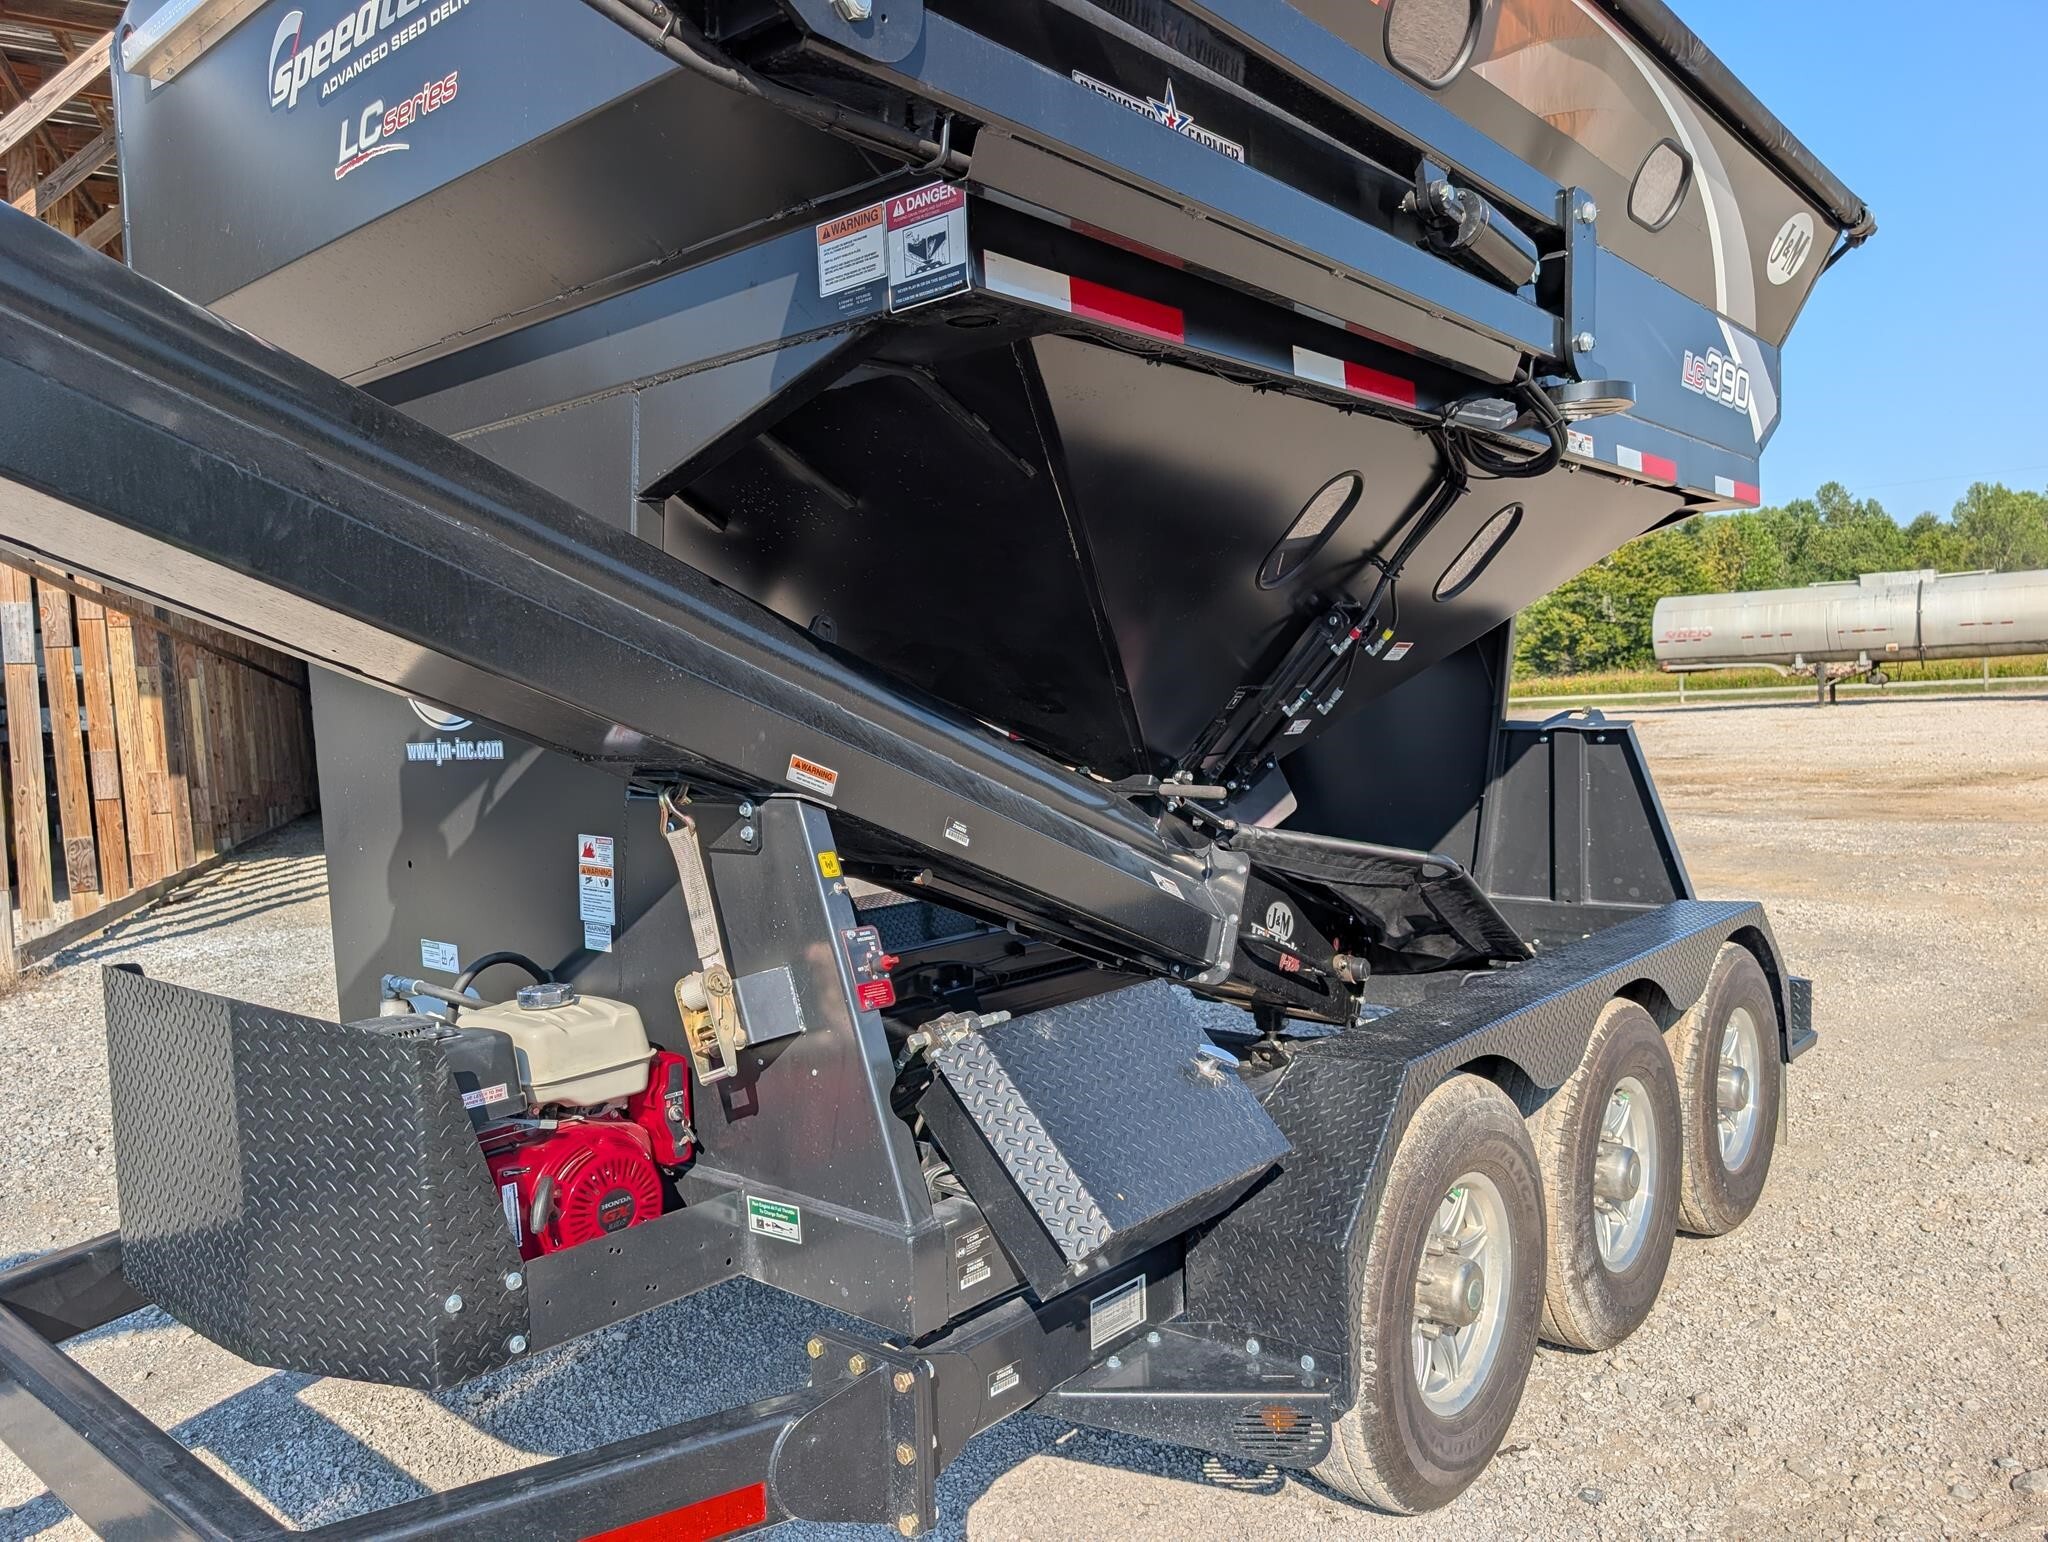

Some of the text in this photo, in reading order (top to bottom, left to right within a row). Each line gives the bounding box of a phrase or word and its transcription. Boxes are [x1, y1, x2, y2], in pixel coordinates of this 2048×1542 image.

[321, 41, 388, 99] ADVANCED
[391, 16, 427, 51] SEED
[906, 184, 957, 213] DANGER
[830, 210, 879, 236] WARNING
[1770, 222, 1811, 276] J&M
[405, 736, 504, 767] www.jm-inc.com
[801, 763, 833, 781] WARNING
[1267, 907, 1291, 937] J&M
[601, 1195, 632, 1210] HONDA
